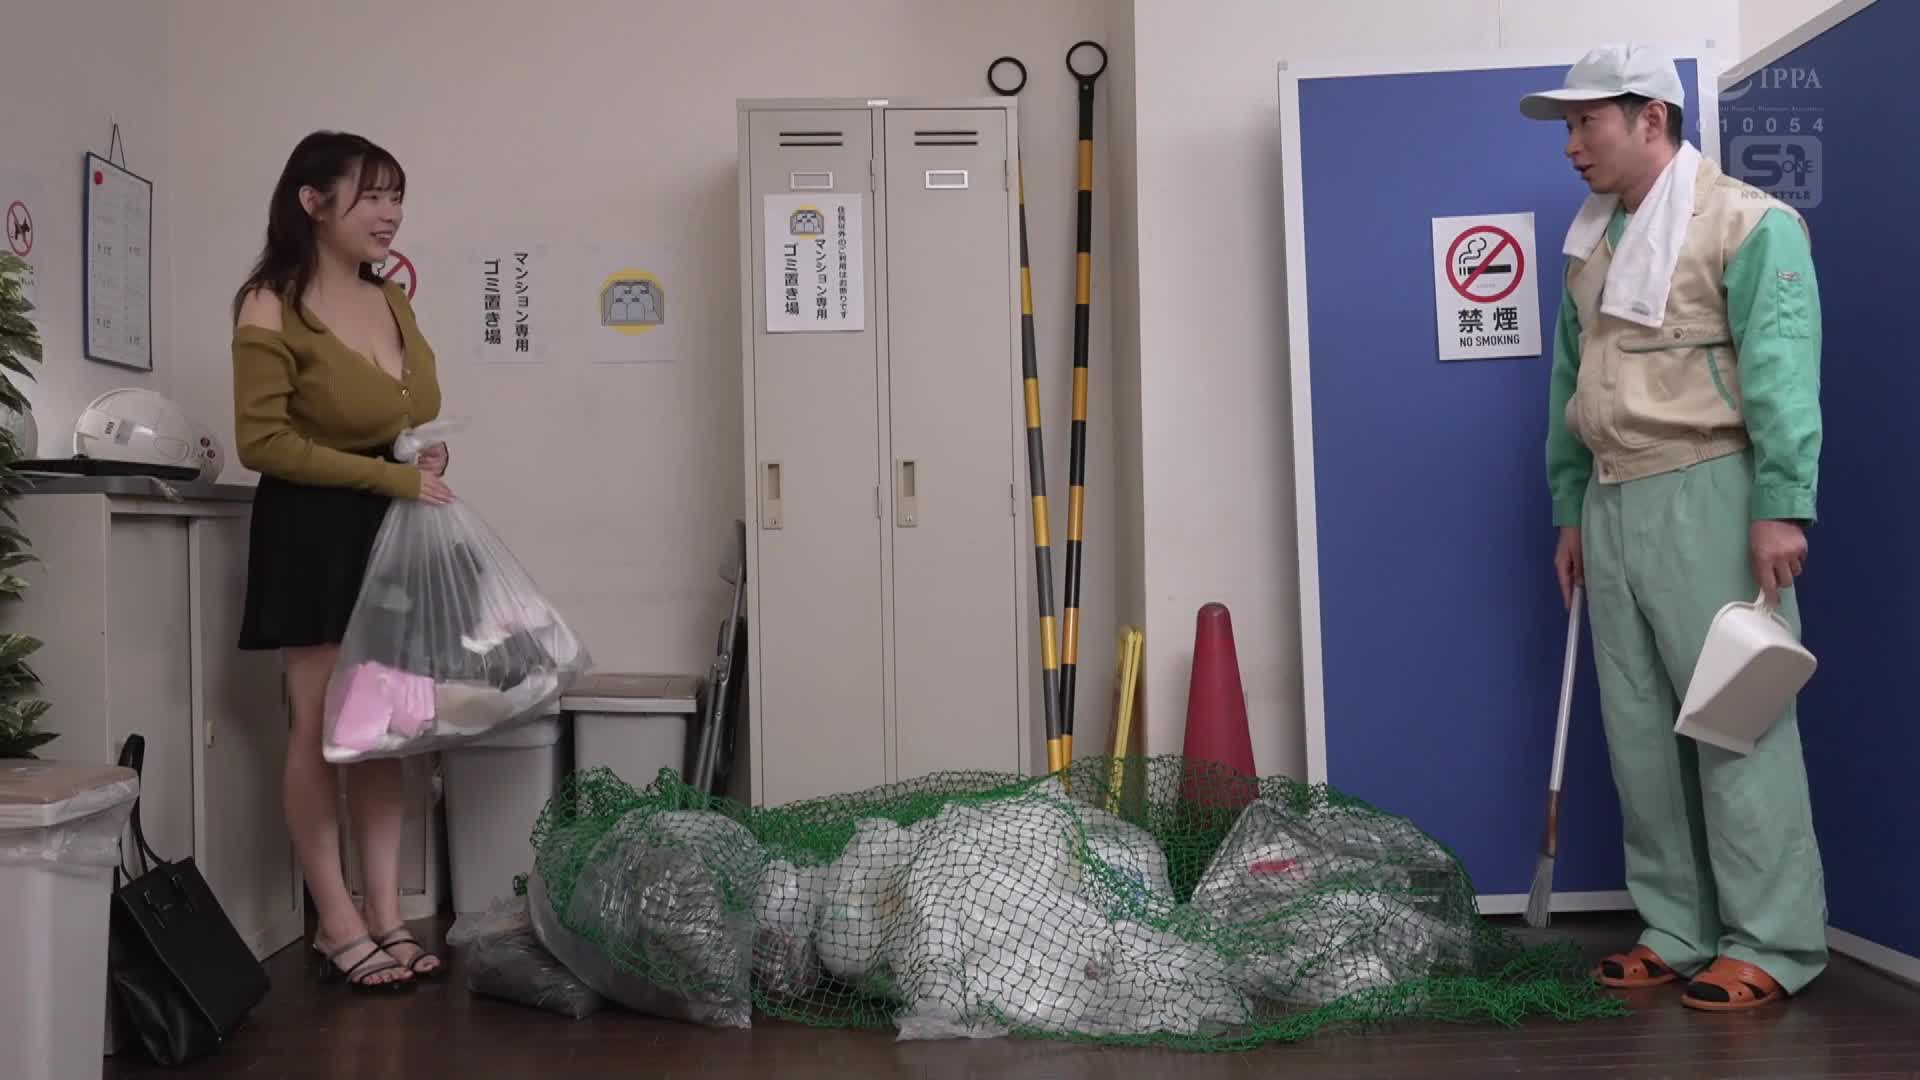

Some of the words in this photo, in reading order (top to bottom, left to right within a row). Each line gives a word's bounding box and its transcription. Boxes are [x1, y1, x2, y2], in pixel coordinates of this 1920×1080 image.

[484, 258, 501, 344] ゴミ置き場
[514, 252, 529, 353] マンション専用
[784, 243, 799, 316] ゴミ置き場
[815, 239, 828, 321] マンション専用
[1458, 306, 1519, 333] 禁煙
[1459, 336, 1473, 348] NO
[1475, 334, 1520, 347] SMOKING
